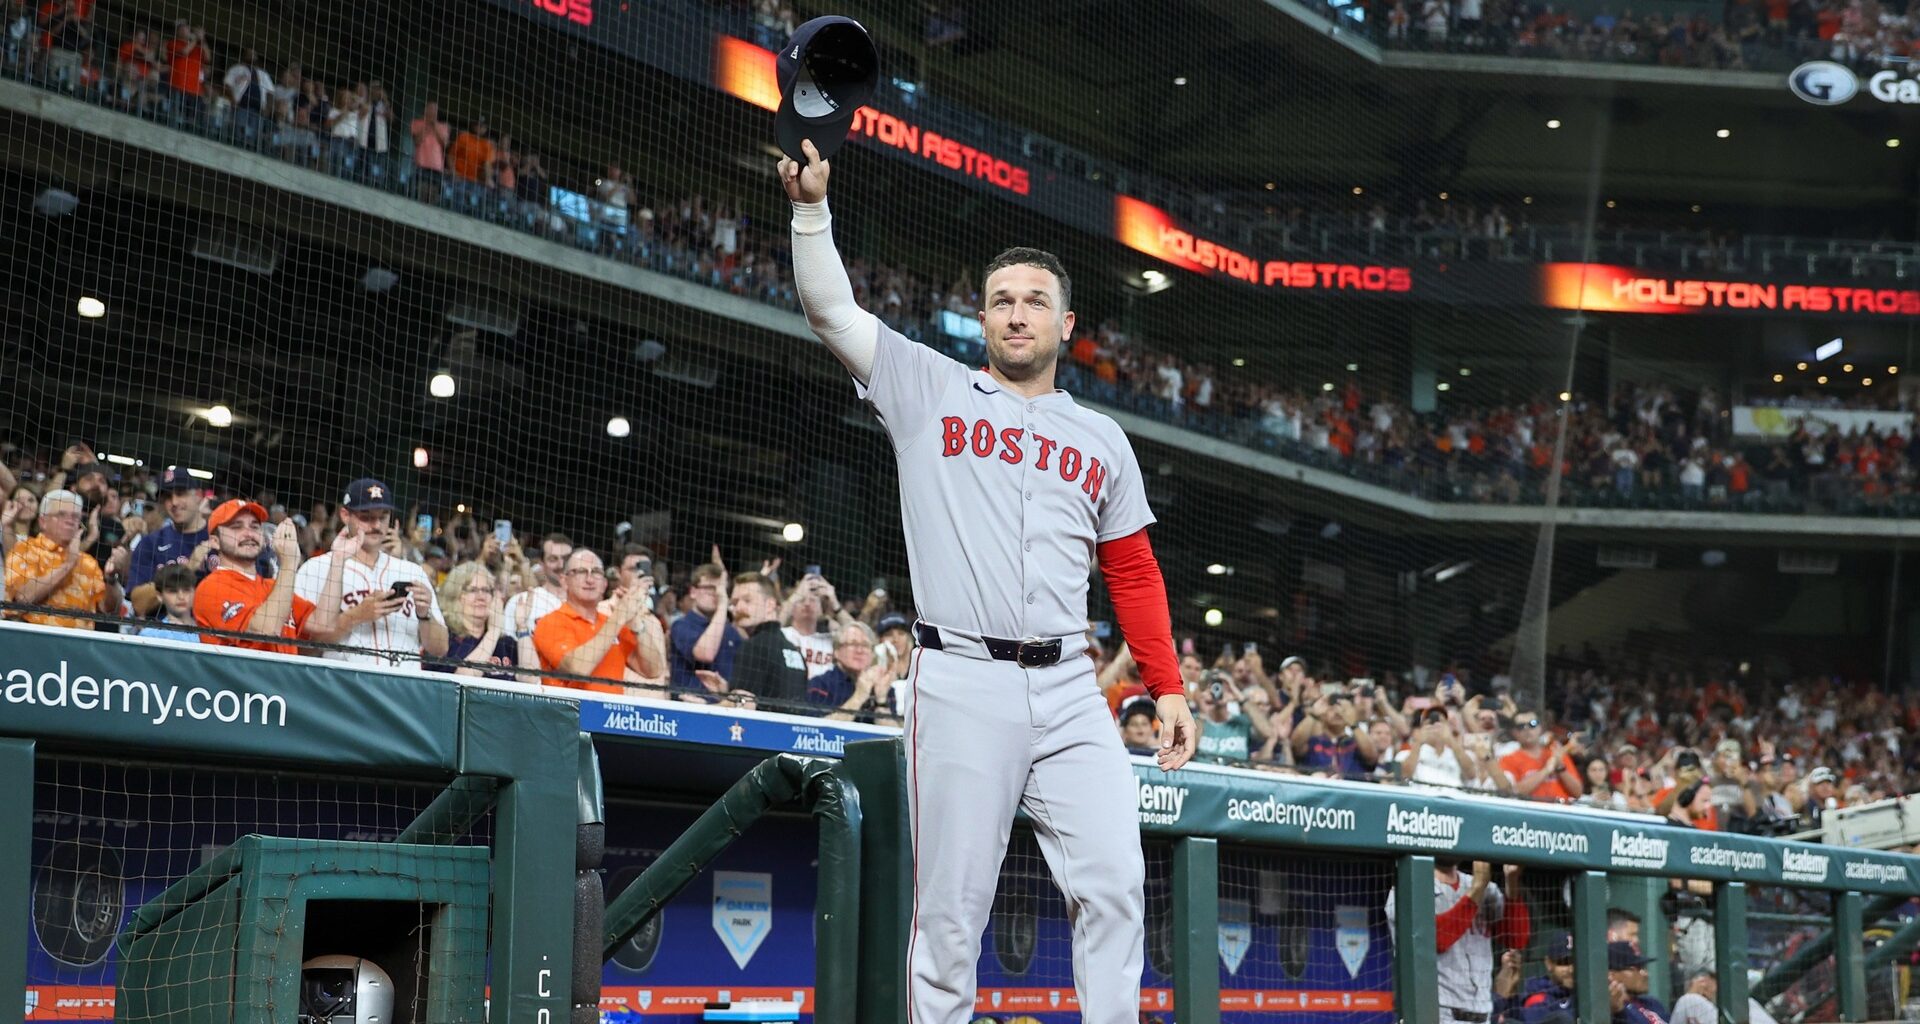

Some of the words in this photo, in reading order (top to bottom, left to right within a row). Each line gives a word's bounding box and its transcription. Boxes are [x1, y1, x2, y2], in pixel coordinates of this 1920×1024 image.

[1869, 70, 1920, 104] Ga
[923, 131, 1030, 196] ASTROS
[1159, 224, 1259, 283] HOUSTON
[1264, 261, 1412, 291] ASTROS
[1612, 278, 1777, 310] HOUSTON
[1783, 285, 1920, 314] ASTROS
[941, 416, 1106, 504] BOSTON
[0, 661, 286, 726] ademy.com
[603, 703, 635, 713] HOUSTON
[603, 711, 678, 737] Methodist
[792, 732, 846, 754] Methodi
[1227, 794, 1356, 833] academy.com
[1387, 802, 1464, 846] Academy
[1492, 821, 1589, 855] academy.com
[1611, 829, 1669, 868] Academy
[1690, 842, 1767, 872] academy.com
[1845, 858, 1907, 884] academy.com
